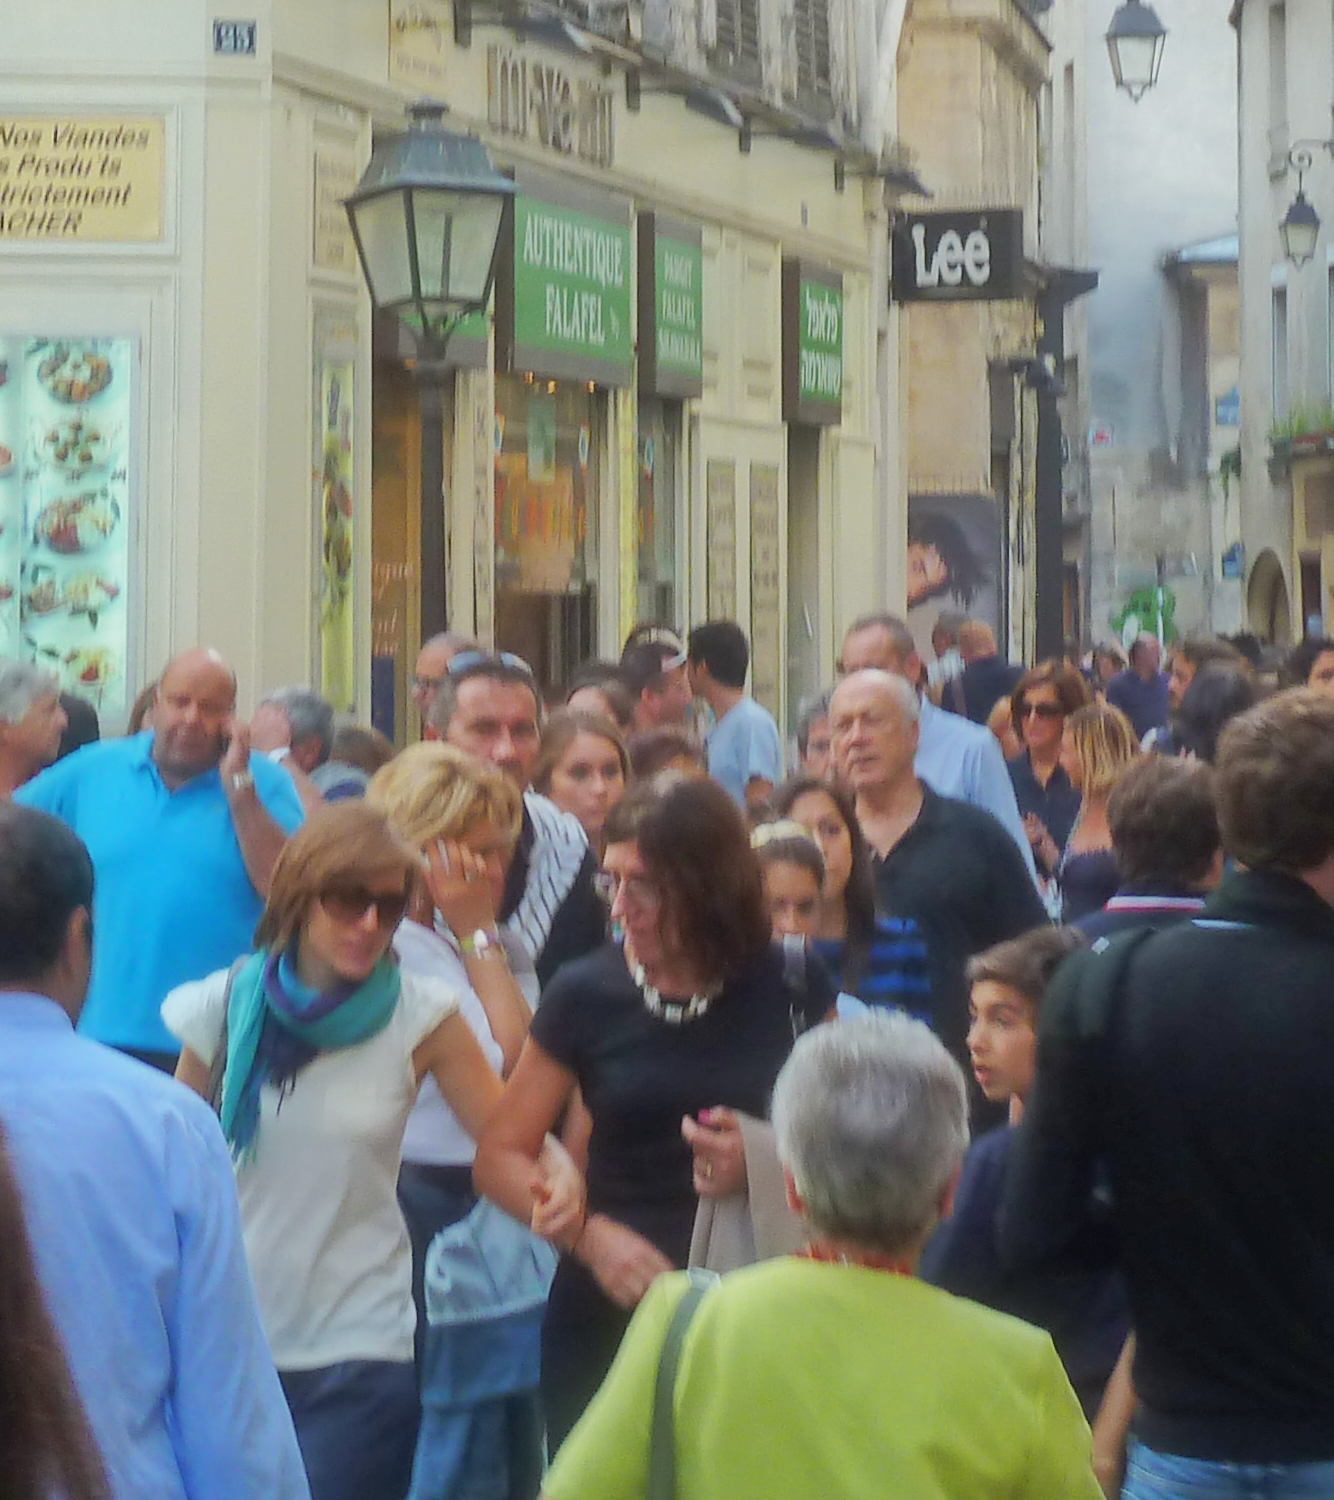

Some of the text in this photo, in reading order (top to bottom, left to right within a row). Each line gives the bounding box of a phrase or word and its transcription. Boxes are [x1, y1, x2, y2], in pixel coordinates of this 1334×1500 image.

[17, 152, 123, 178] Produts
[53, 122, 150, 150] Viandes
[523, 211, 624, 291] AUTHENTIQUE
[911, 223, 991, 288] Lee
[545, 283, 606, 347] FALAFEL
